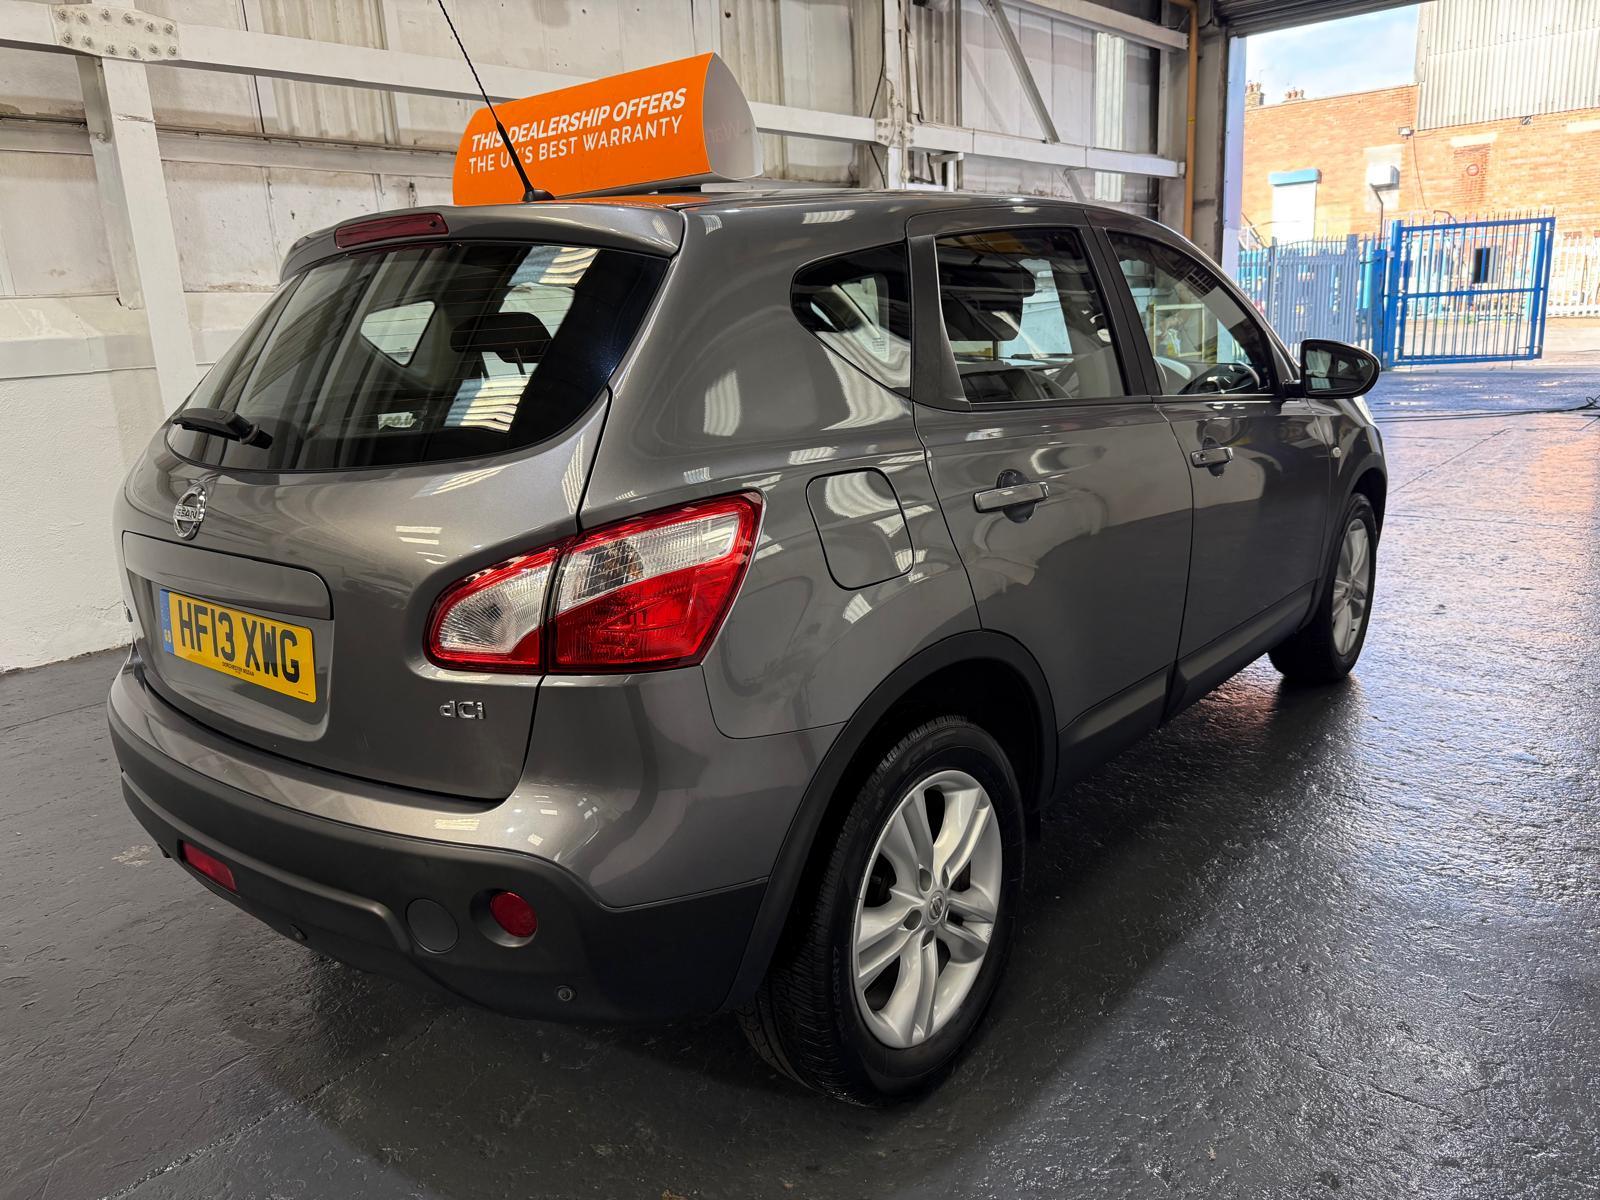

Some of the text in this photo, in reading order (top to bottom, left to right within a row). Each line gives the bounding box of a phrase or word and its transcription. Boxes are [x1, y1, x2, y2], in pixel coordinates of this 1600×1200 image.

[468, 153, 495, 175] THE
[539, 136, 578, 161] BEST
[582, 114, 683, 152] WARRANTY
[472, 87, 687, 152] THIS DEALERSHIP OFFERS
[178, 599, 300, 684] HF13 XWG
[440, 700, 484, 719] dCi
